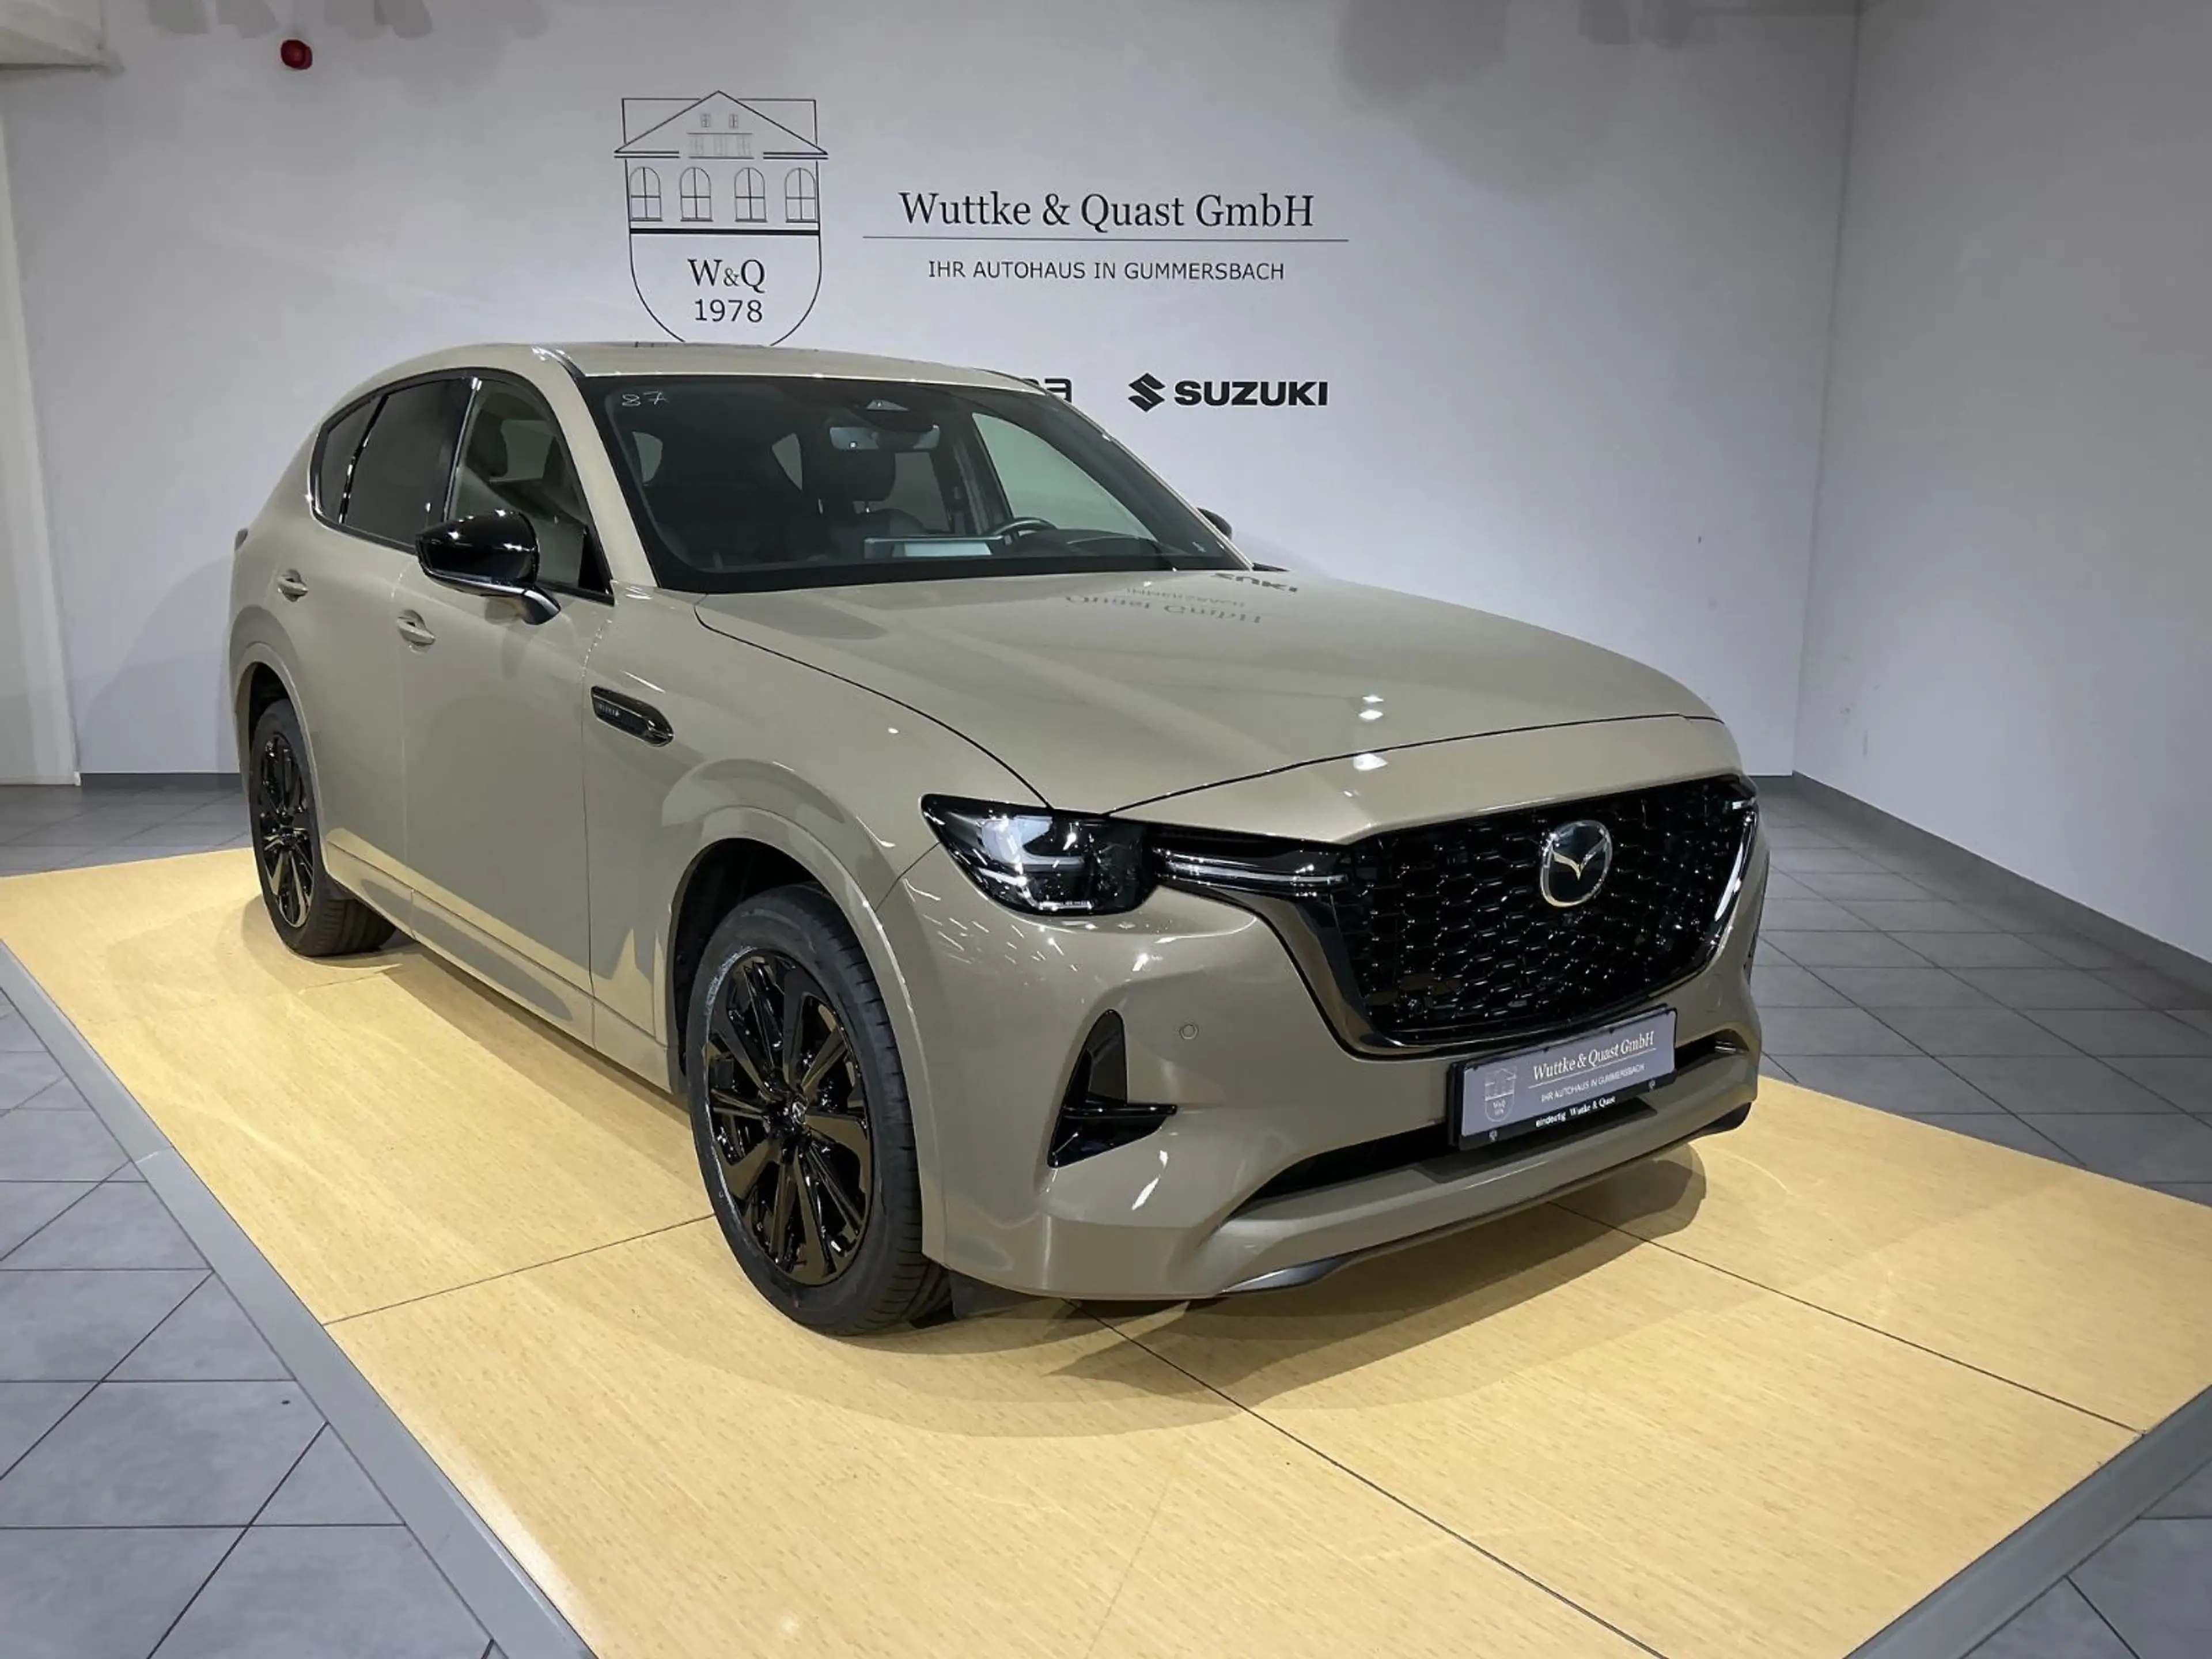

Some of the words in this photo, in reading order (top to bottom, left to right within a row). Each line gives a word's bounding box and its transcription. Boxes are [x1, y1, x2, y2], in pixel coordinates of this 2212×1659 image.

[898, 191, 1031, 225] Wuttke
[1042, 193, 1071, 226] &
[1081, 193, 1185, 233] Quast
[1196, 192, 1315, 228] GmbH
[687, 258, 765, 293] W&Q
[929, 260, 966, 278] IHR
[973, 261, 1086, 279] AUTOHAUS
[1094, 262, 1116, 279] IN
[1124, 262, 1284, 281] GUMMERSBACH
[695, 298, 763, 323] 1978
[1174, 380, 1328, 407] SUZUKI
[1533, 1056, 1576, 1081] Wuttke
[1577, 1052, 1587, 1069] &
[1588, 1043, 1619, 1067] Quast
[1620, 1030, 1655, 1055] GmbH
